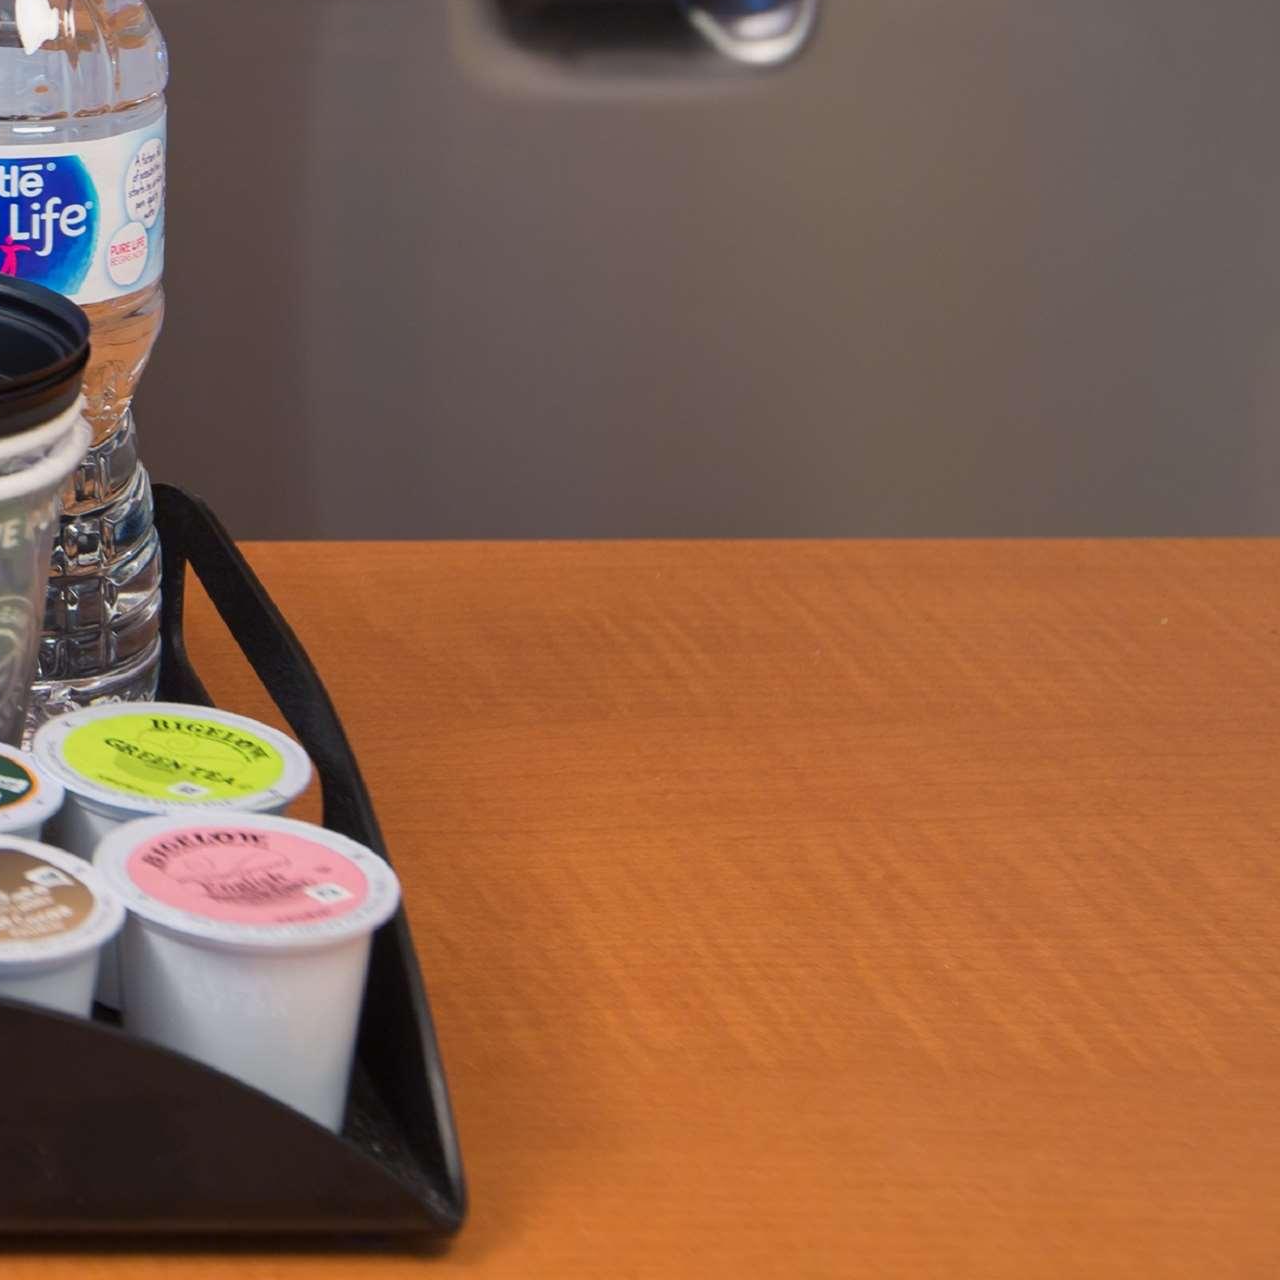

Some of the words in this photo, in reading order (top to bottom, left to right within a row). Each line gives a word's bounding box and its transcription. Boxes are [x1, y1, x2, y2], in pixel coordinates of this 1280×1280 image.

[9, 197, 87, 257] Life
[104, 738, 183, 771] GREEN
[190, 766, 236, 786] TEA
[151, 718, 271, 761] BIGELOW
